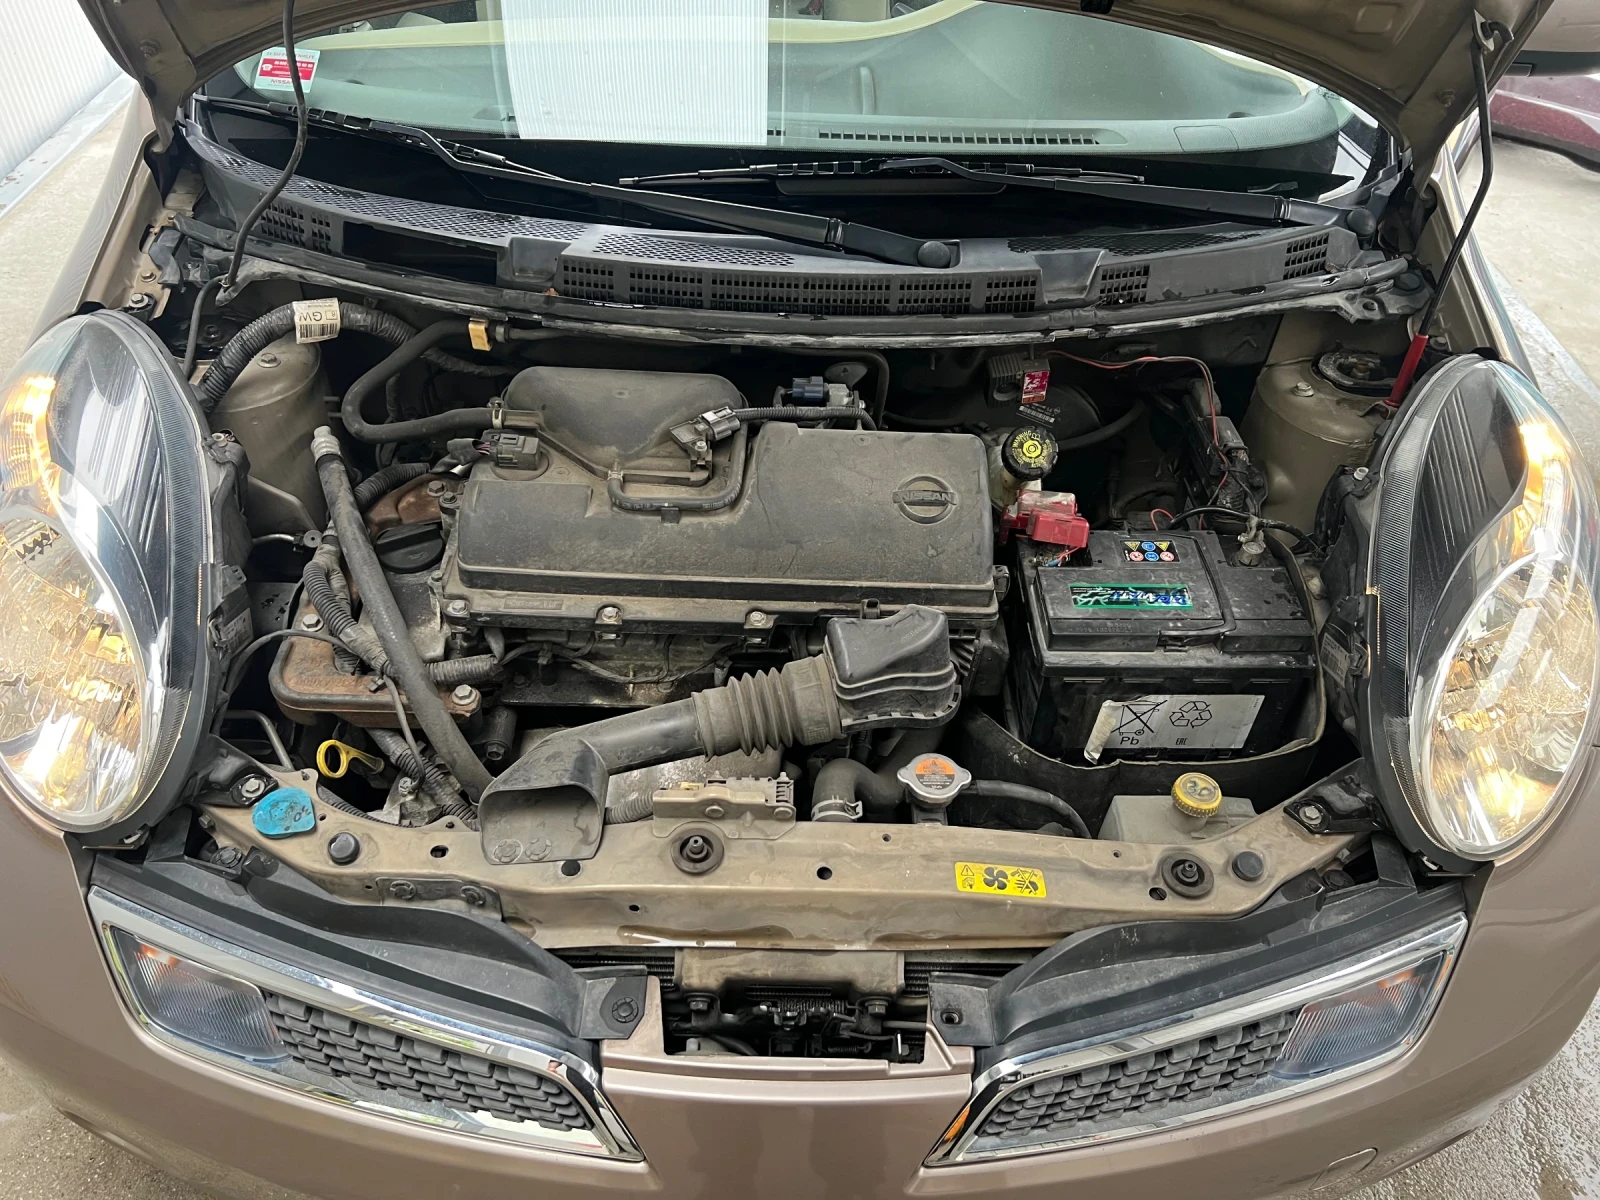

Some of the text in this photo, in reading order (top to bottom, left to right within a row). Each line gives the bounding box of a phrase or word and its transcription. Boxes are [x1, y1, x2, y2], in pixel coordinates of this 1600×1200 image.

[299, 311, 323, 322] GW
[894, 491, 952, 502] NISSAN
[1119, 736, 1140, 746] Pb
